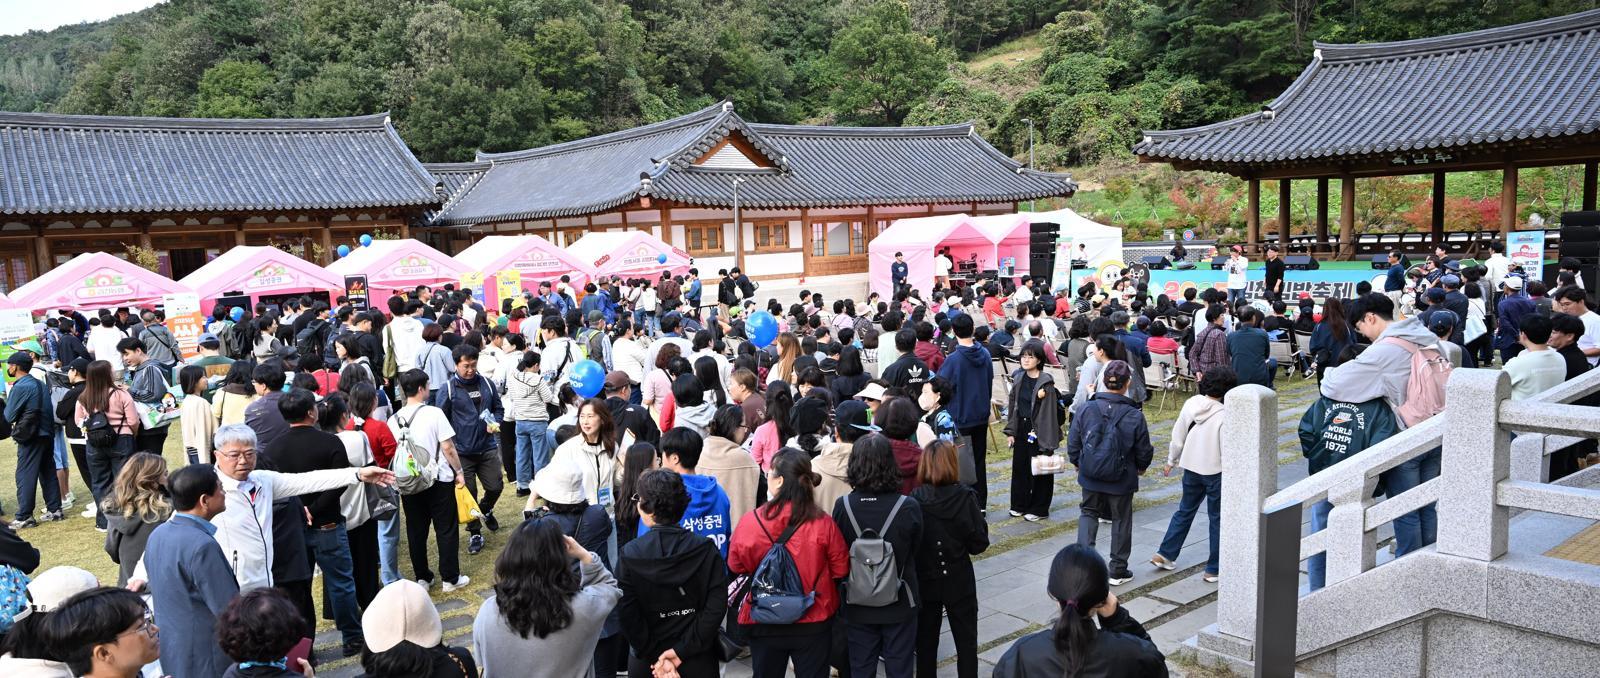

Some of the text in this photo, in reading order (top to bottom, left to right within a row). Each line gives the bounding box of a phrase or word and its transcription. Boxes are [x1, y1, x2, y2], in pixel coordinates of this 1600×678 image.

[1332, 402, 1359, 413] ATHLETIC
[1328, 425, 1353, 436] WORLD
[1323, 432, 1352, 444] CHAMPS
[1325, 441, 1347, 454] 1972
